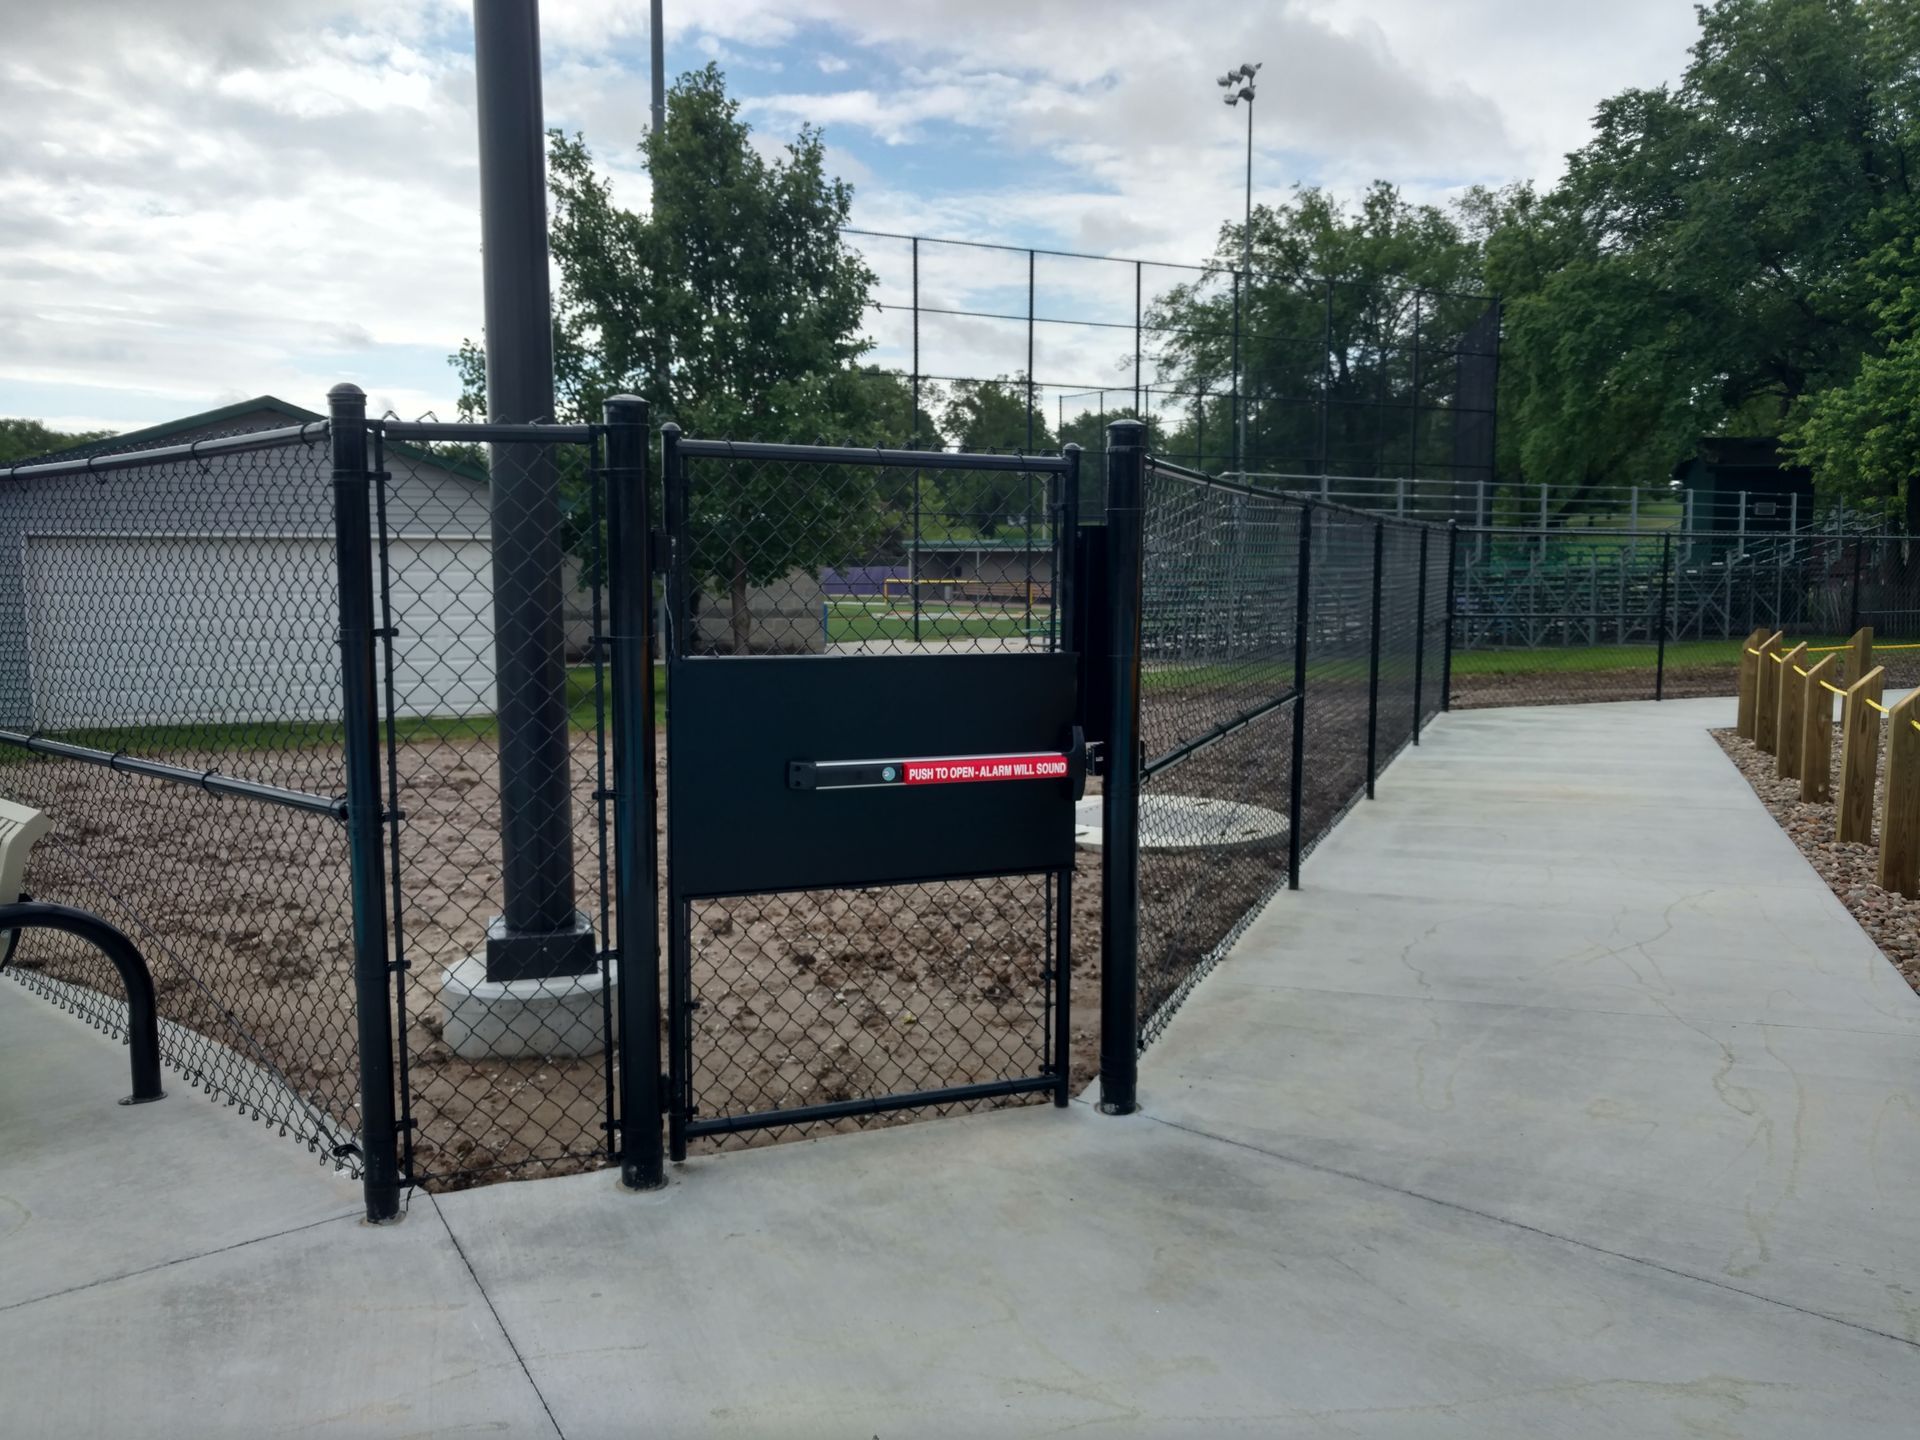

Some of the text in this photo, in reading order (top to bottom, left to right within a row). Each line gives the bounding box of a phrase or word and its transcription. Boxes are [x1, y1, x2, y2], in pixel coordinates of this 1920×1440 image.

[909, 767, 934, 781] PUSH
[935, 767, 948, 779] TO
[1013, 763, 1035, 776] WILL
[1036, 761, 1067, 775] SOUND
